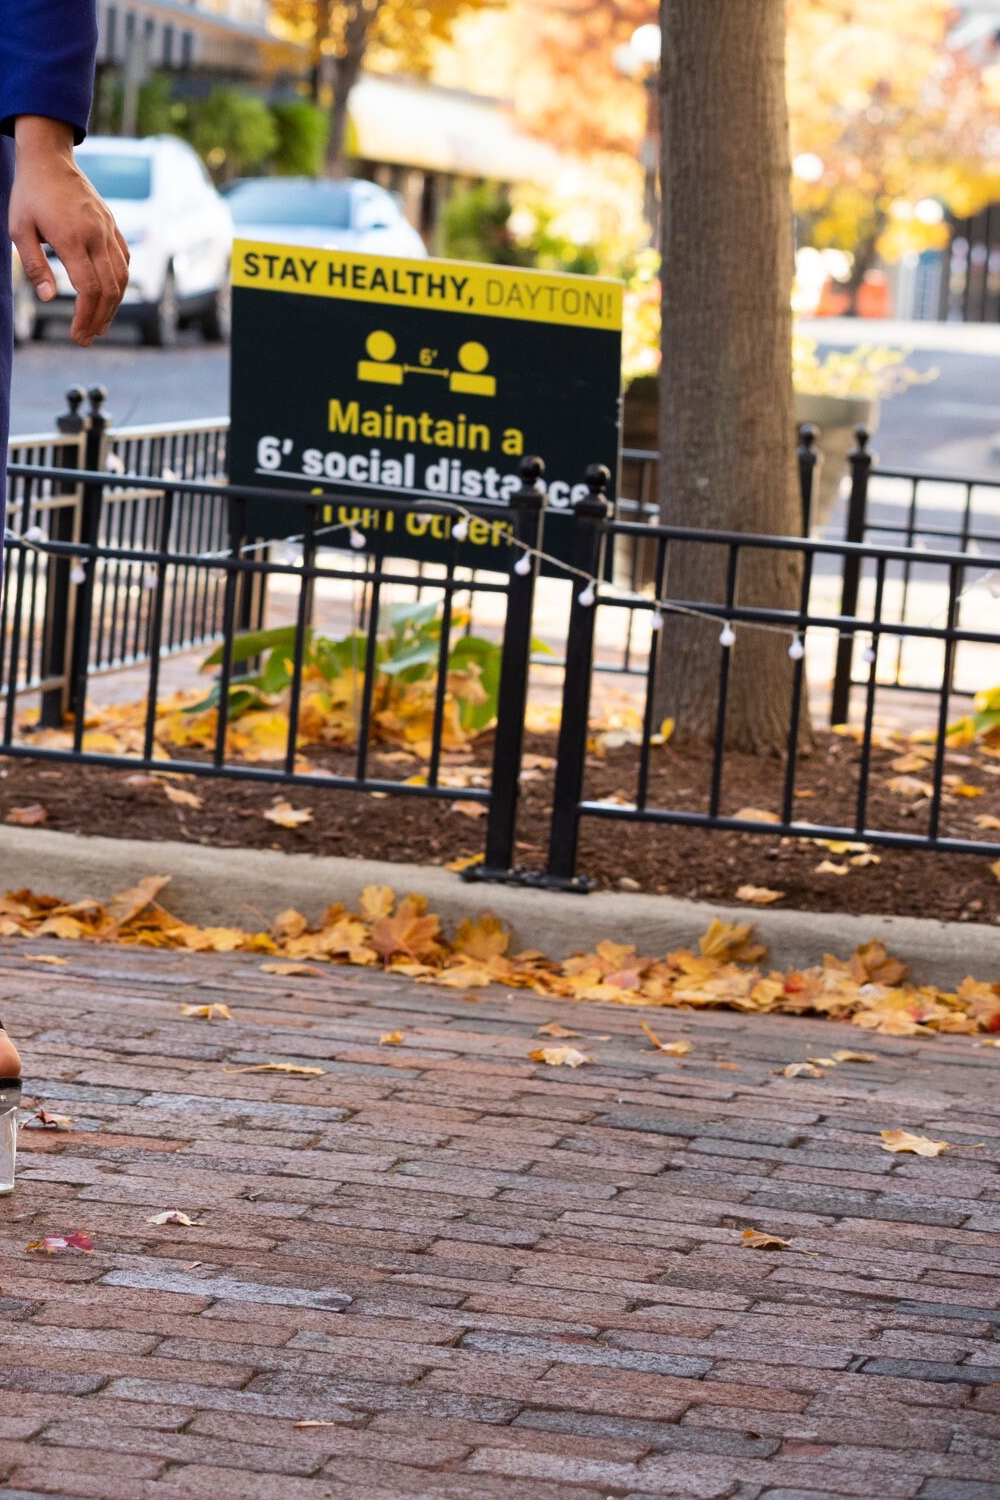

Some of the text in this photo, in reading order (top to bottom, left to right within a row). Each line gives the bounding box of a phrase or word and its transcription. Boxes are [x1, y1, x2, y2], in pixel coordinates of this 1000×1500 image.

[243, 251, 613, 319] STAY HEALTHY, DAYTON!
[419, 348, 438, 367] 6'
[328, 398, 524, 456] Maintain a
[256, 435, 294, 470] 6'
[302, 448, 415, 489] social
[405, 512, 514, 548] oter
